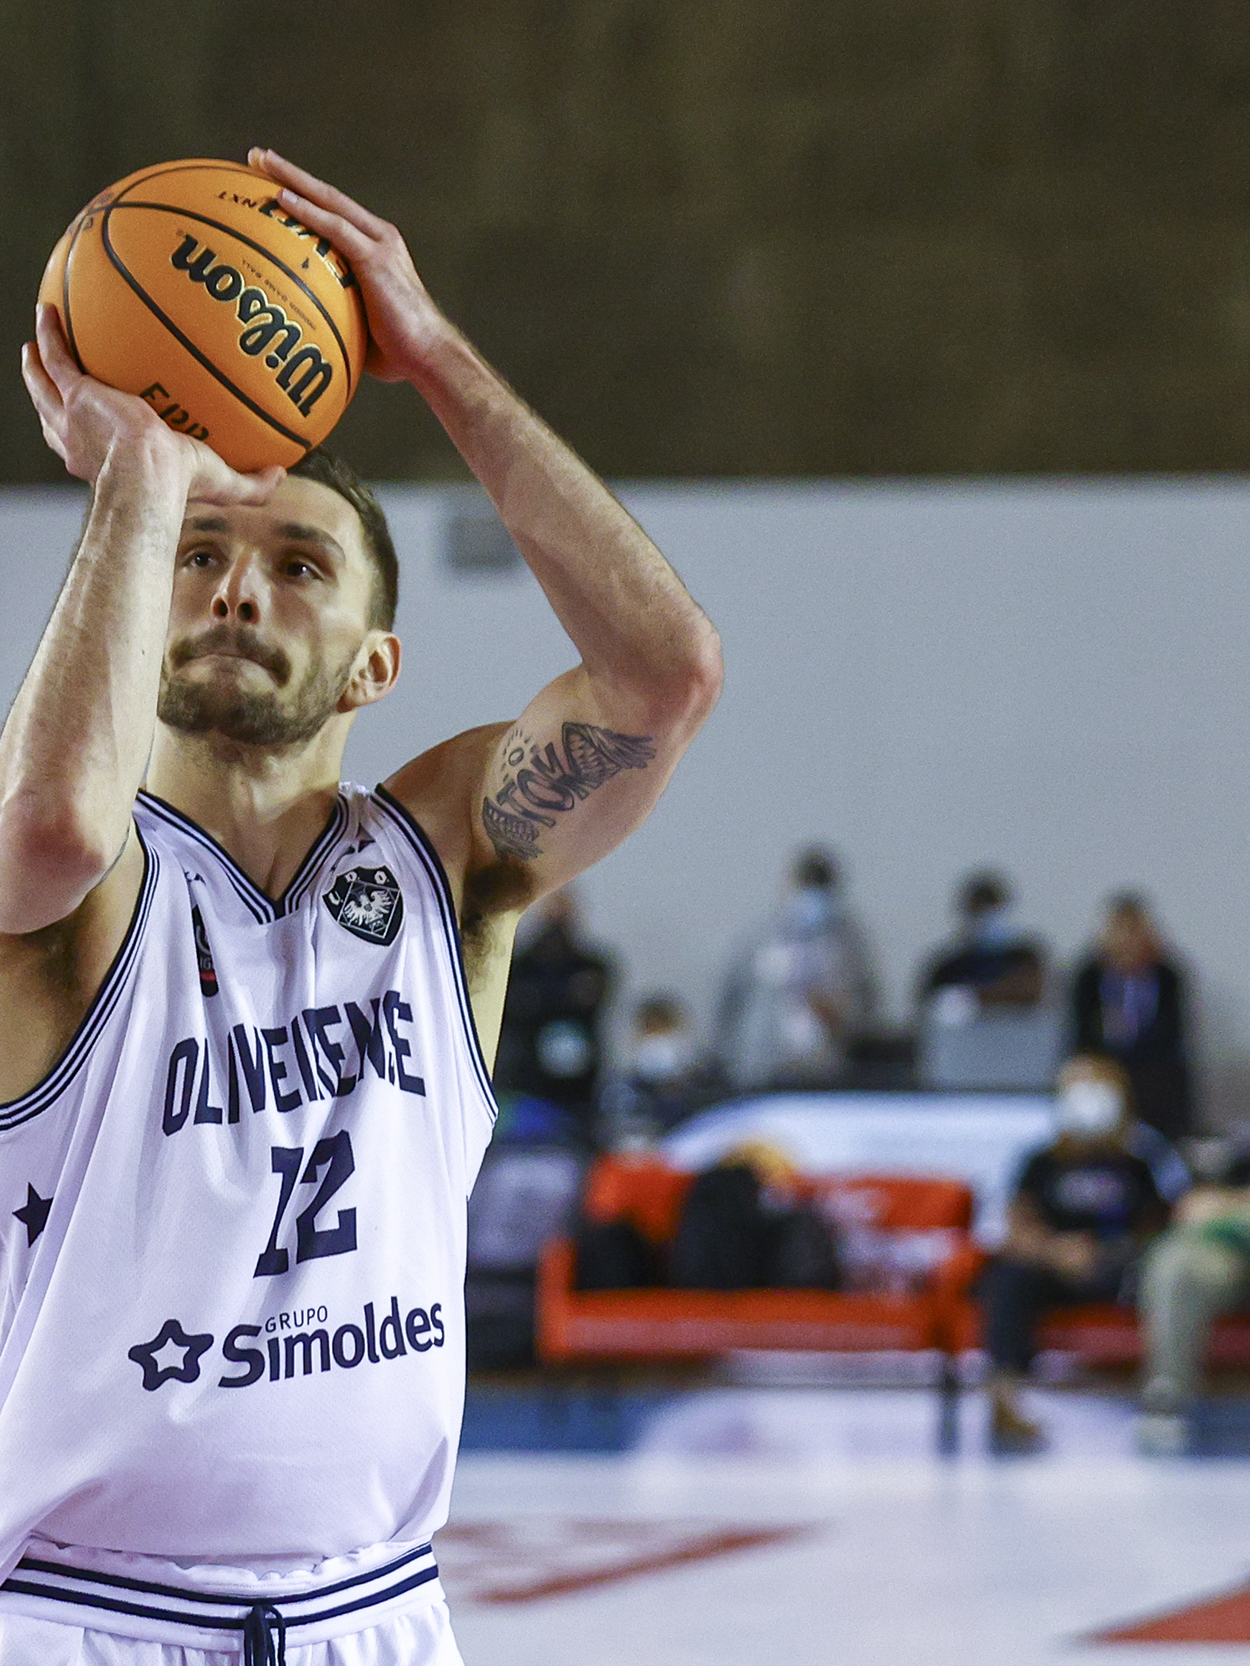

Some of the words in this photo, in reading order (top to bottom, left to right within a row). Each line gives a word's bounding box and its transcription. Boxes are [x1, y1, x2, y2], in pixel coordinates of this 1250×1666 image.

[170, 233, 333, 418] Wilson
[253, 1129, 358, 1278] 12
[217, 1295, 446, 1388] Simoldes
[265, 1305, 329, 1333] GRUPO
